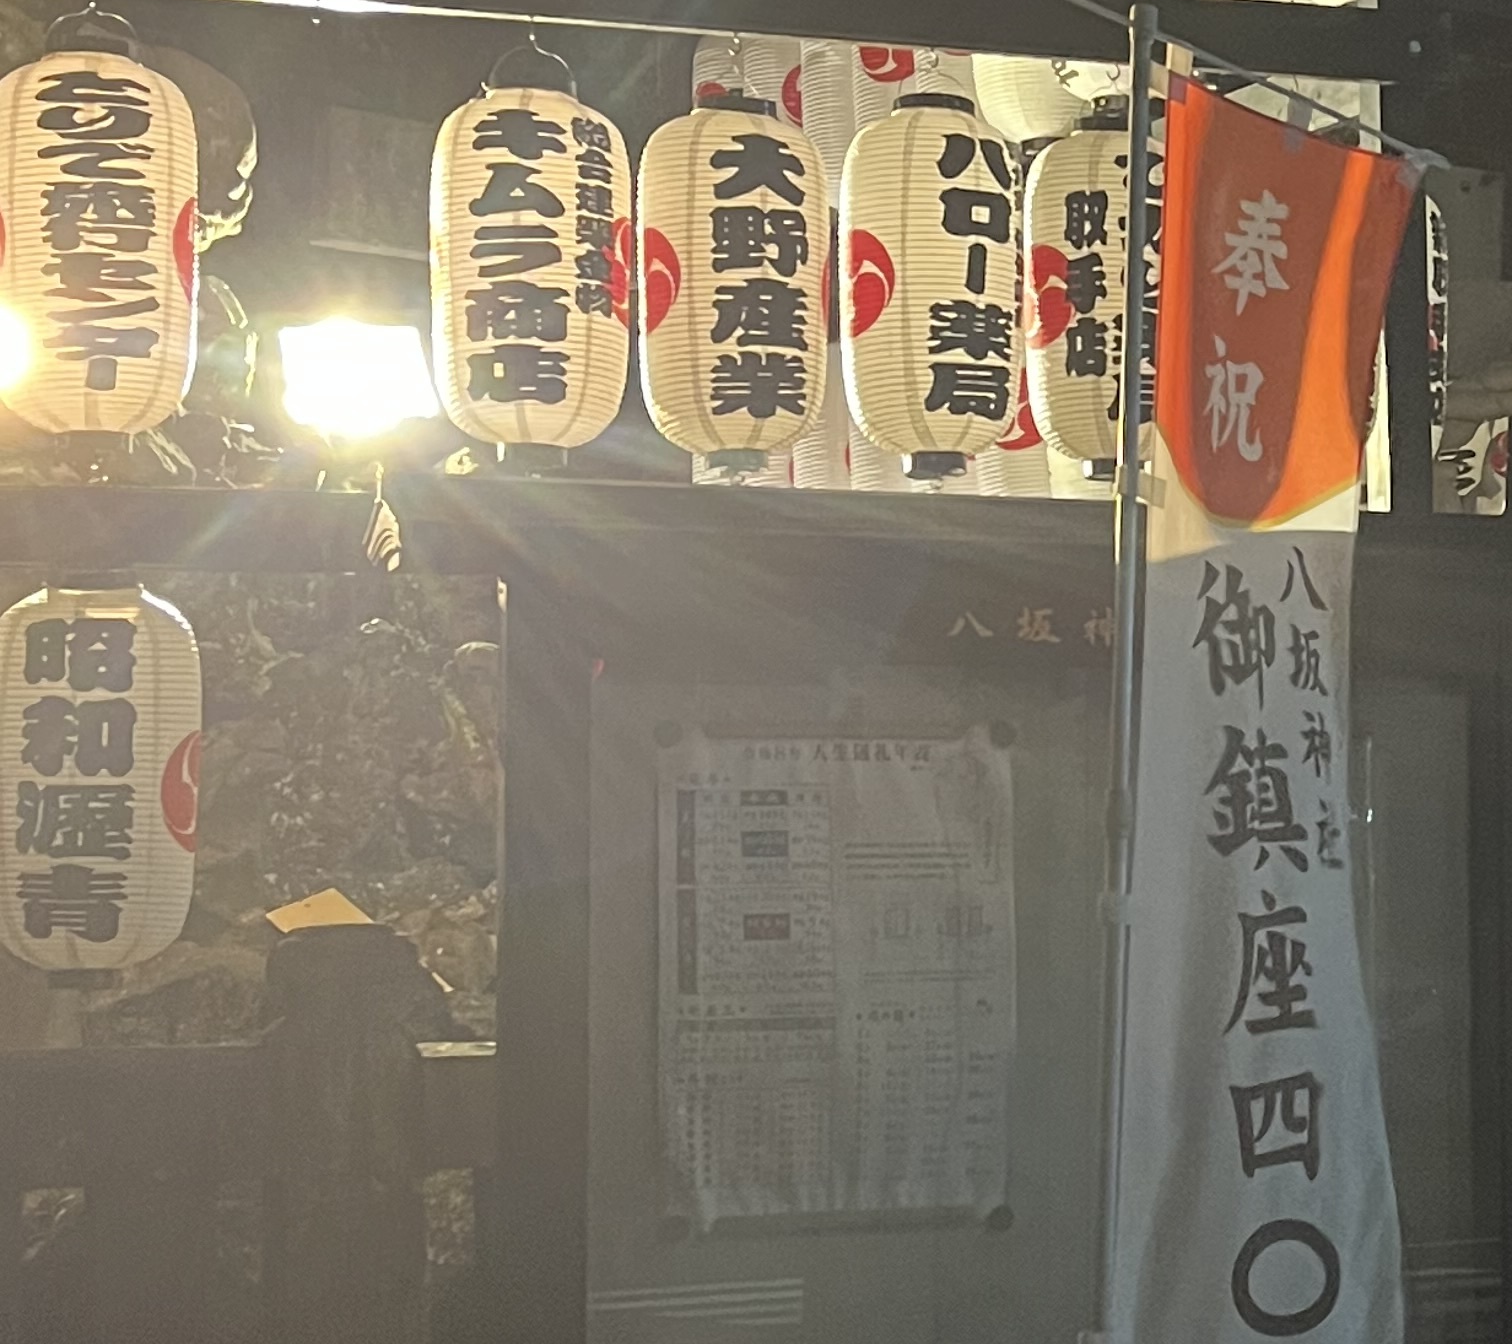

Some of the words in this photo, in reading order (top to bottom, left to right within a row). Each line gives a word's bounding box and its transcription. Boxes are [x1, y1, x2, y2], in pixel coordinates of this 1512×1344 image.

[35, 71, 160, 391] とりで旅行センター
[465, 109, 571, 404] キムラ商店
[710, 134, 808, 419] 大野産業
[924, 134, 1014, 420] ハロー薬局
[1203, 189, 1291, 463] 奉祝
[1280, 545, 1344, 870] 八坂神社
